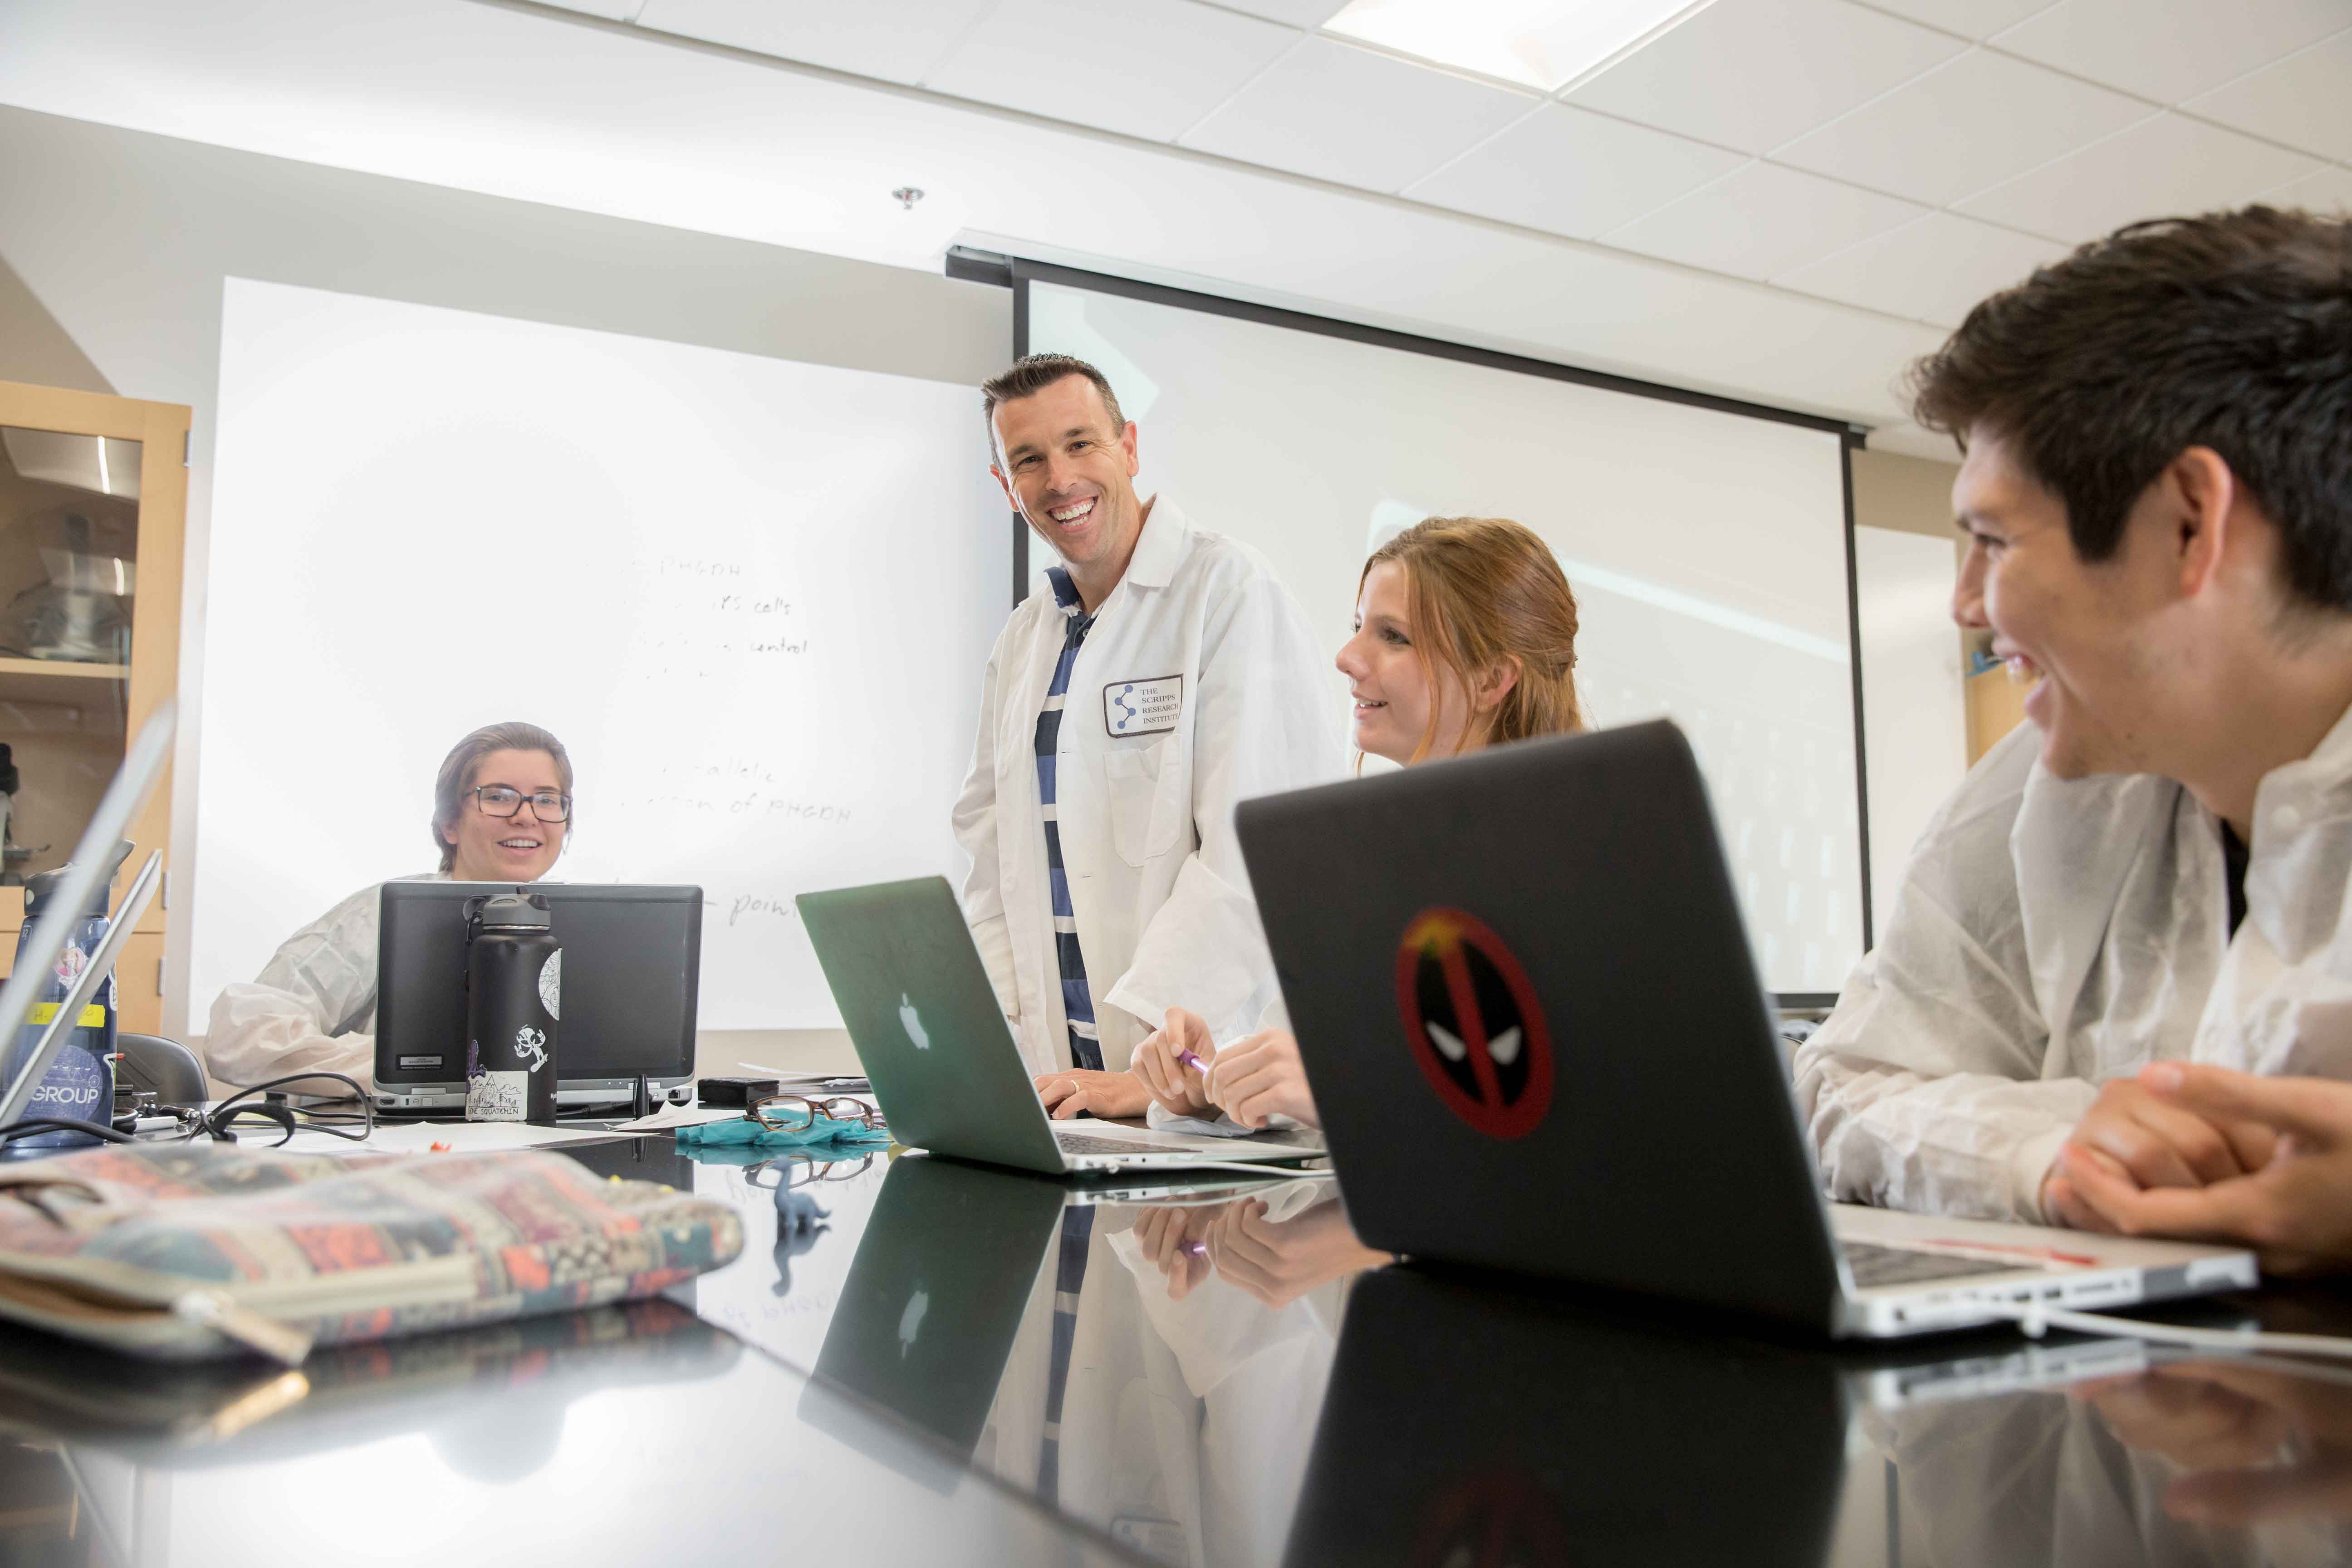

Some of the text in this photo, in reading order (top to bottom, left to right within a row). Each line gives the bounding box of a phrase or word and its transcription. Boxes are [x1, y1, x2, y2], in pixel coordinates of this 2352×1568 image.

[750, 637, 808, 655] control
[1142, 694, 1176, 704] SCRIPPS
[1142, 704, 1178, 714] RESEARCH
[1143, 714, 1178, 724] INSTITUTE
[729, 791, 759, 813] of
[766, 798, 851, 824] PHGDH
[32, 1086, 98, 1104] GROUP
